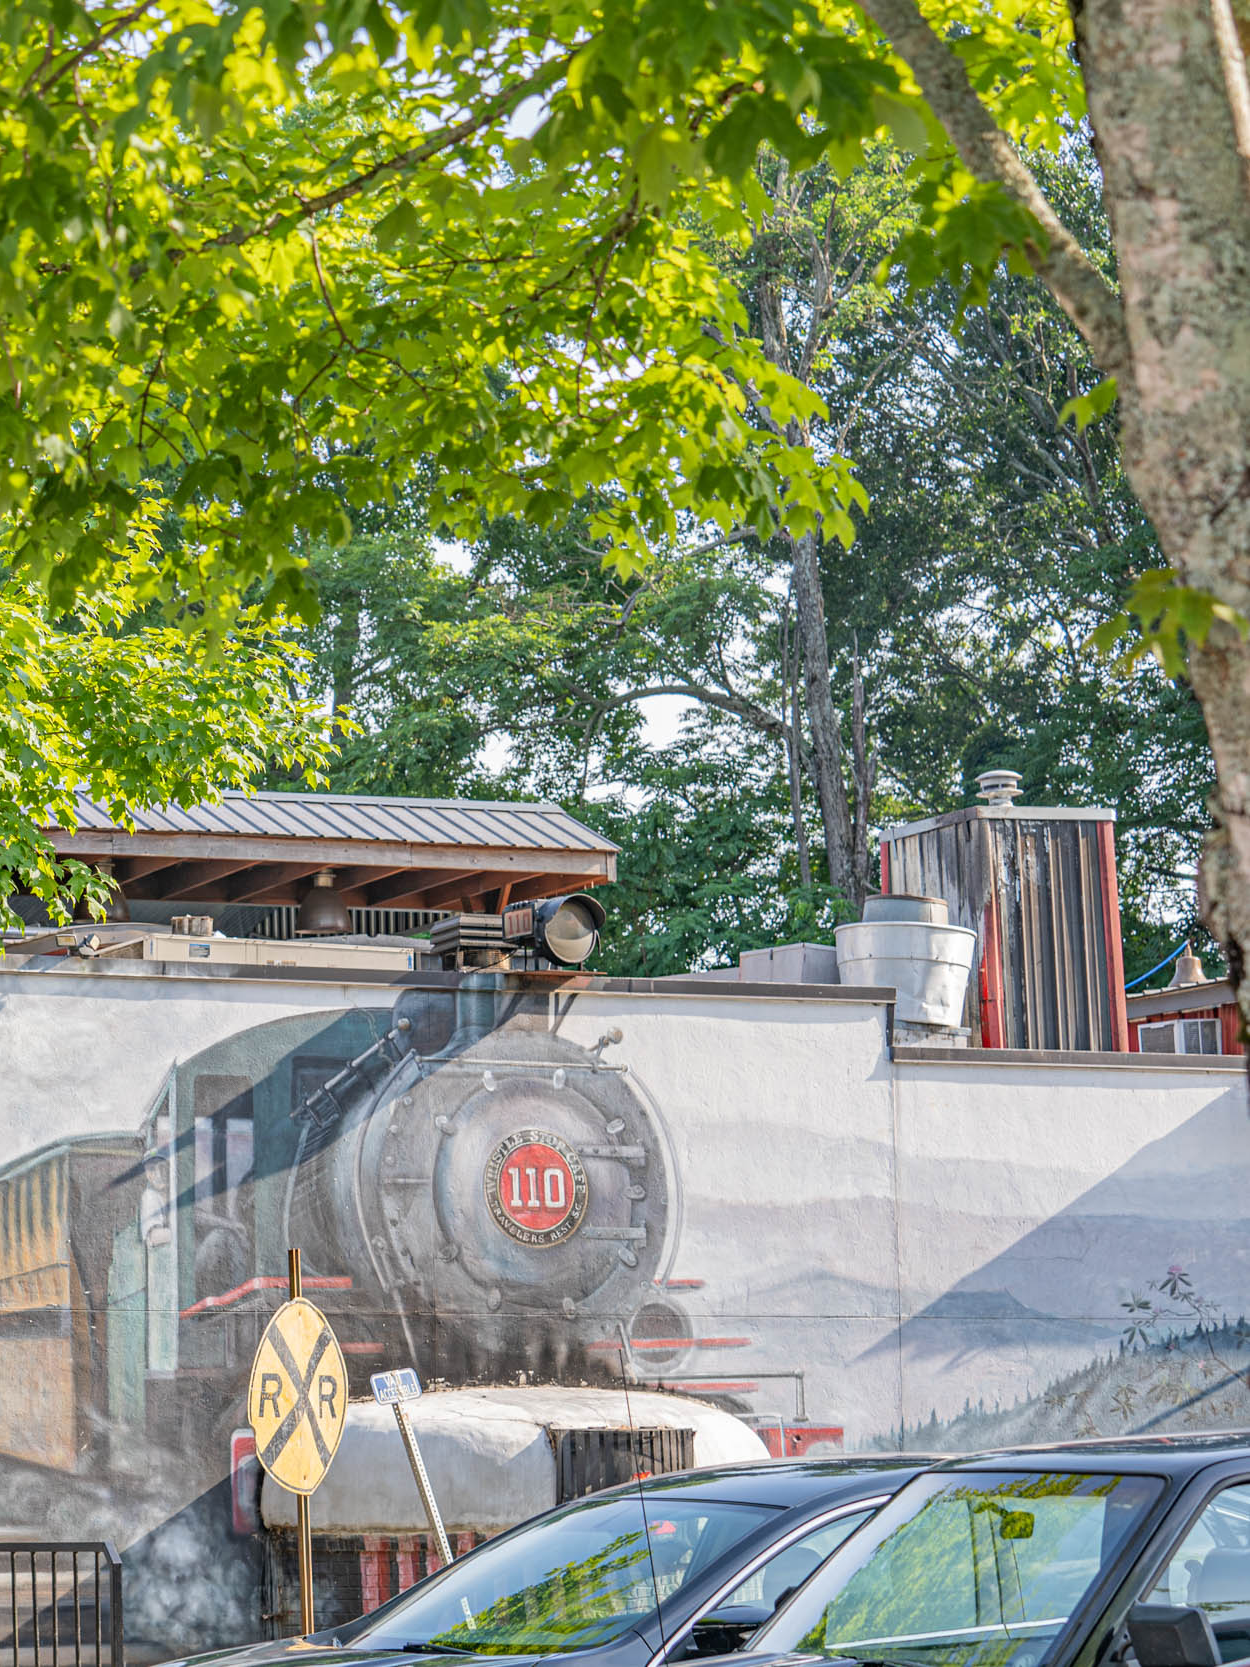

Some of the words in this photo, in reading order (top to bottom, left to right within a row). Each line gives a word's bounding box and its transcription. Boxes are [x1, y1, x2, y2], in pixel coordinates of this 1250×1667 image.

[508, 1167, 566, 1208] 110
[550, 1222, 572, 1241] REST
[258, 1372, 283, 1418] R
[318, 1375, 338, 1419] R
